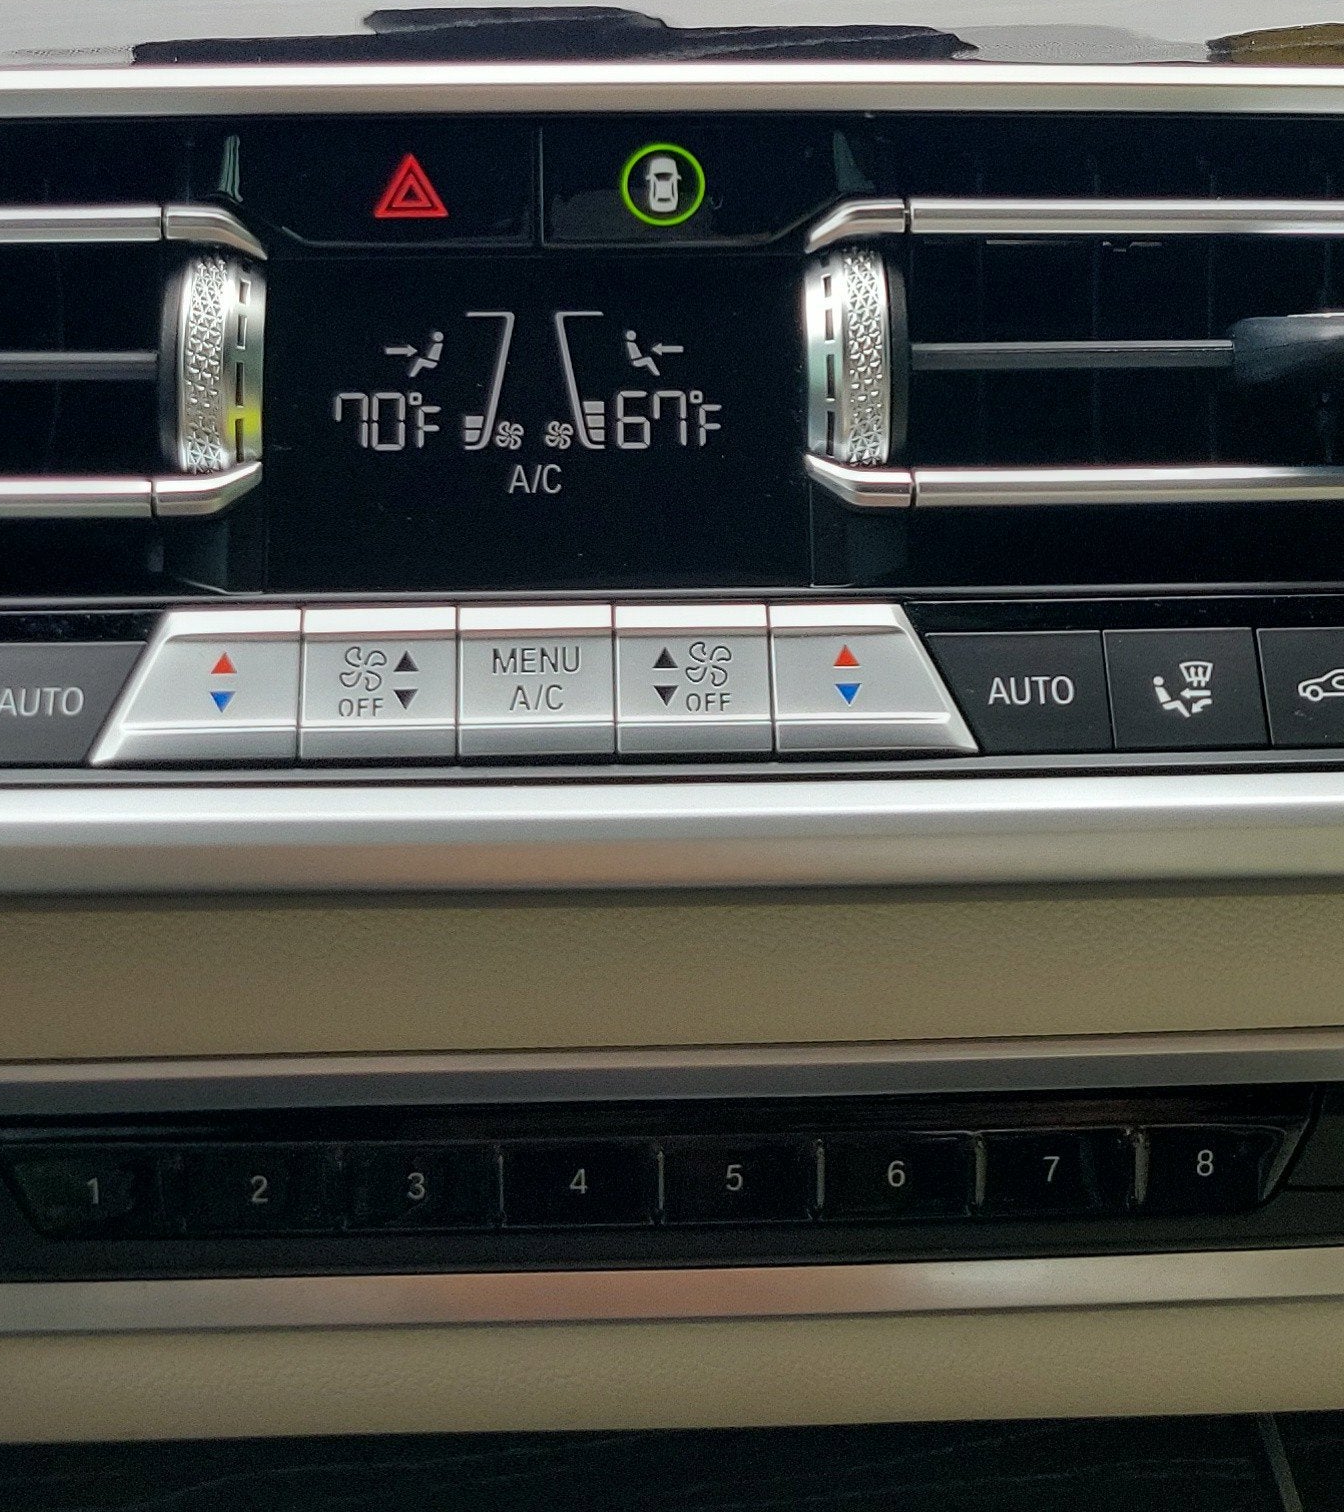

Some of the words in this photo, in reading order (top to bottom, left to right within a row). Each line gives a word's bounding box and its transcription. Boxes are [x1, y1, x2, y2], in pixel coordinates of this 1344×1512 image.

[508, 464, 561, 493] A/C
[492, 647, 582, 675] MENU
[509, 683, 563, 710] A/C
[686, 693, 730, 711] OFF
[989, 676, 1074, 705] AUTO
[338, 698, 383, 716] OFF
[887, 1160, 905, 1187] 6
[1044, 1156, 1060, 1182] 7
[1197, 1149, 1213, 1176] 8
[87, 1178, 98, 1203] 1
[251, 1175, 268, 1203] 2
[408, 1172, 425, 1199] 3
[570, 1168, 587, 1194] 4
[726, 1164, 743, 1191] 5
